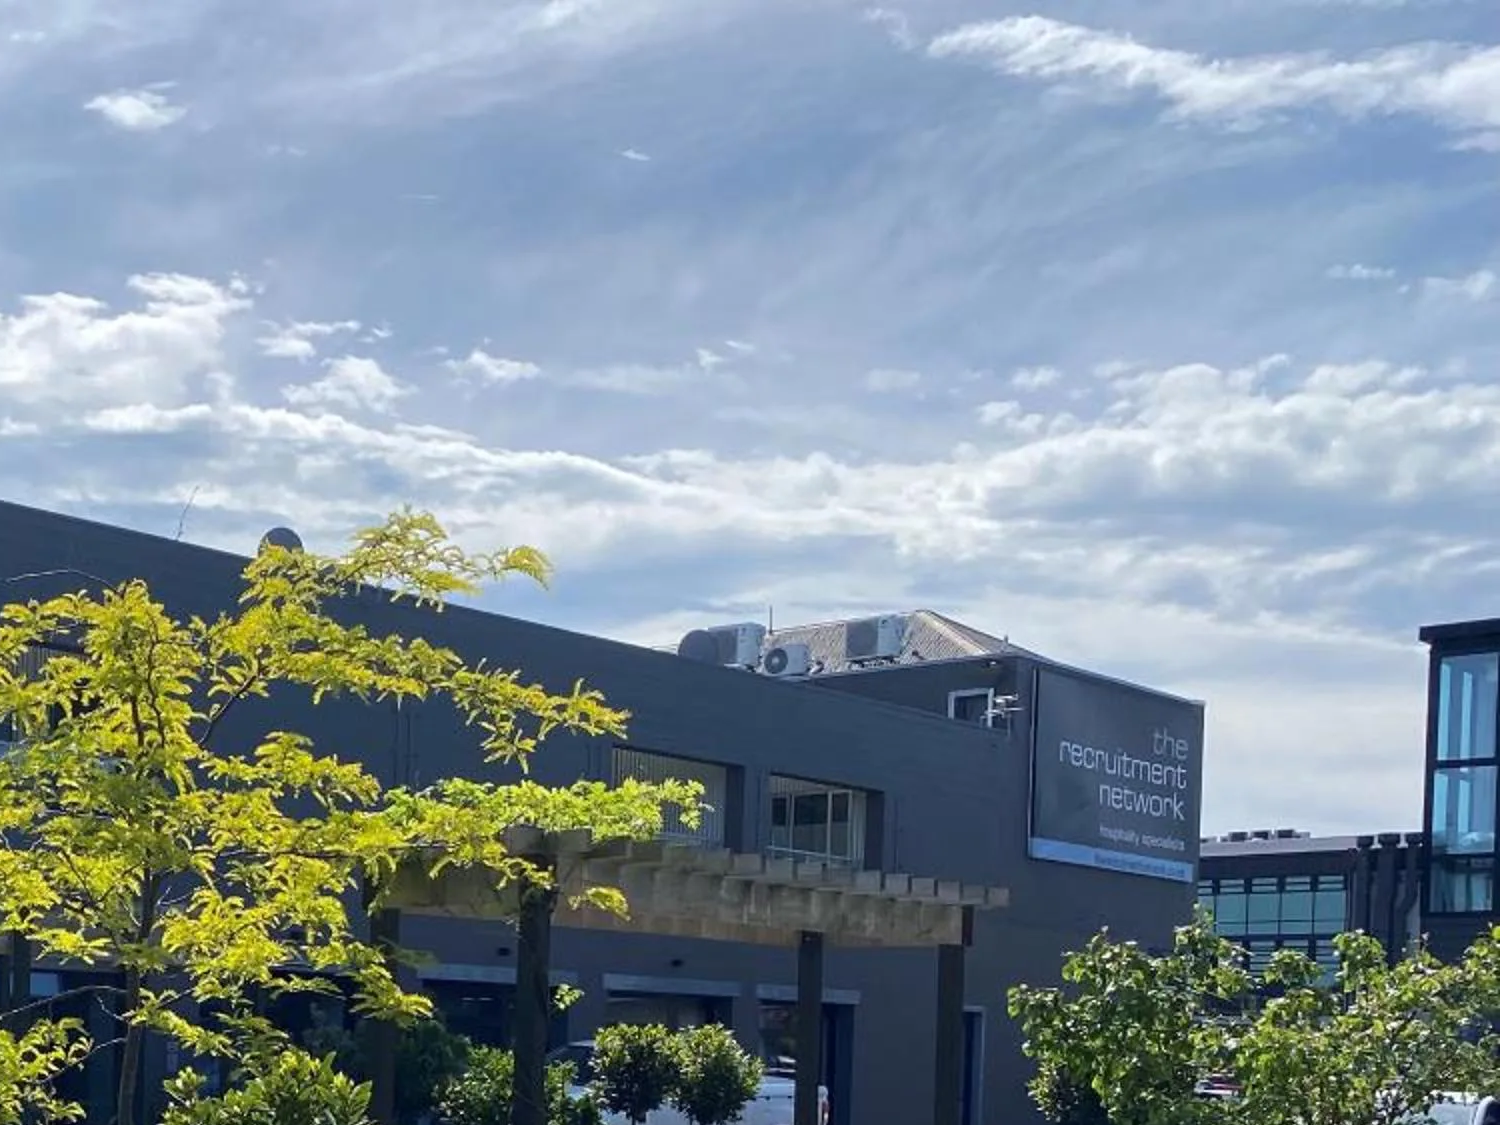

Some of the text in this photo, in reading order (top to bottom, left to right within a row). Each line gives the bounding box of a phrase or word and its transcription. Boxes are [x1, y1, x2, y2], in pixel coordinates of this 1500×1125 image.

[1153, 727, 1189, 761] the
[1059, 741, 1188, 789] recruitment
[1099, 784, 1185, 821] network
